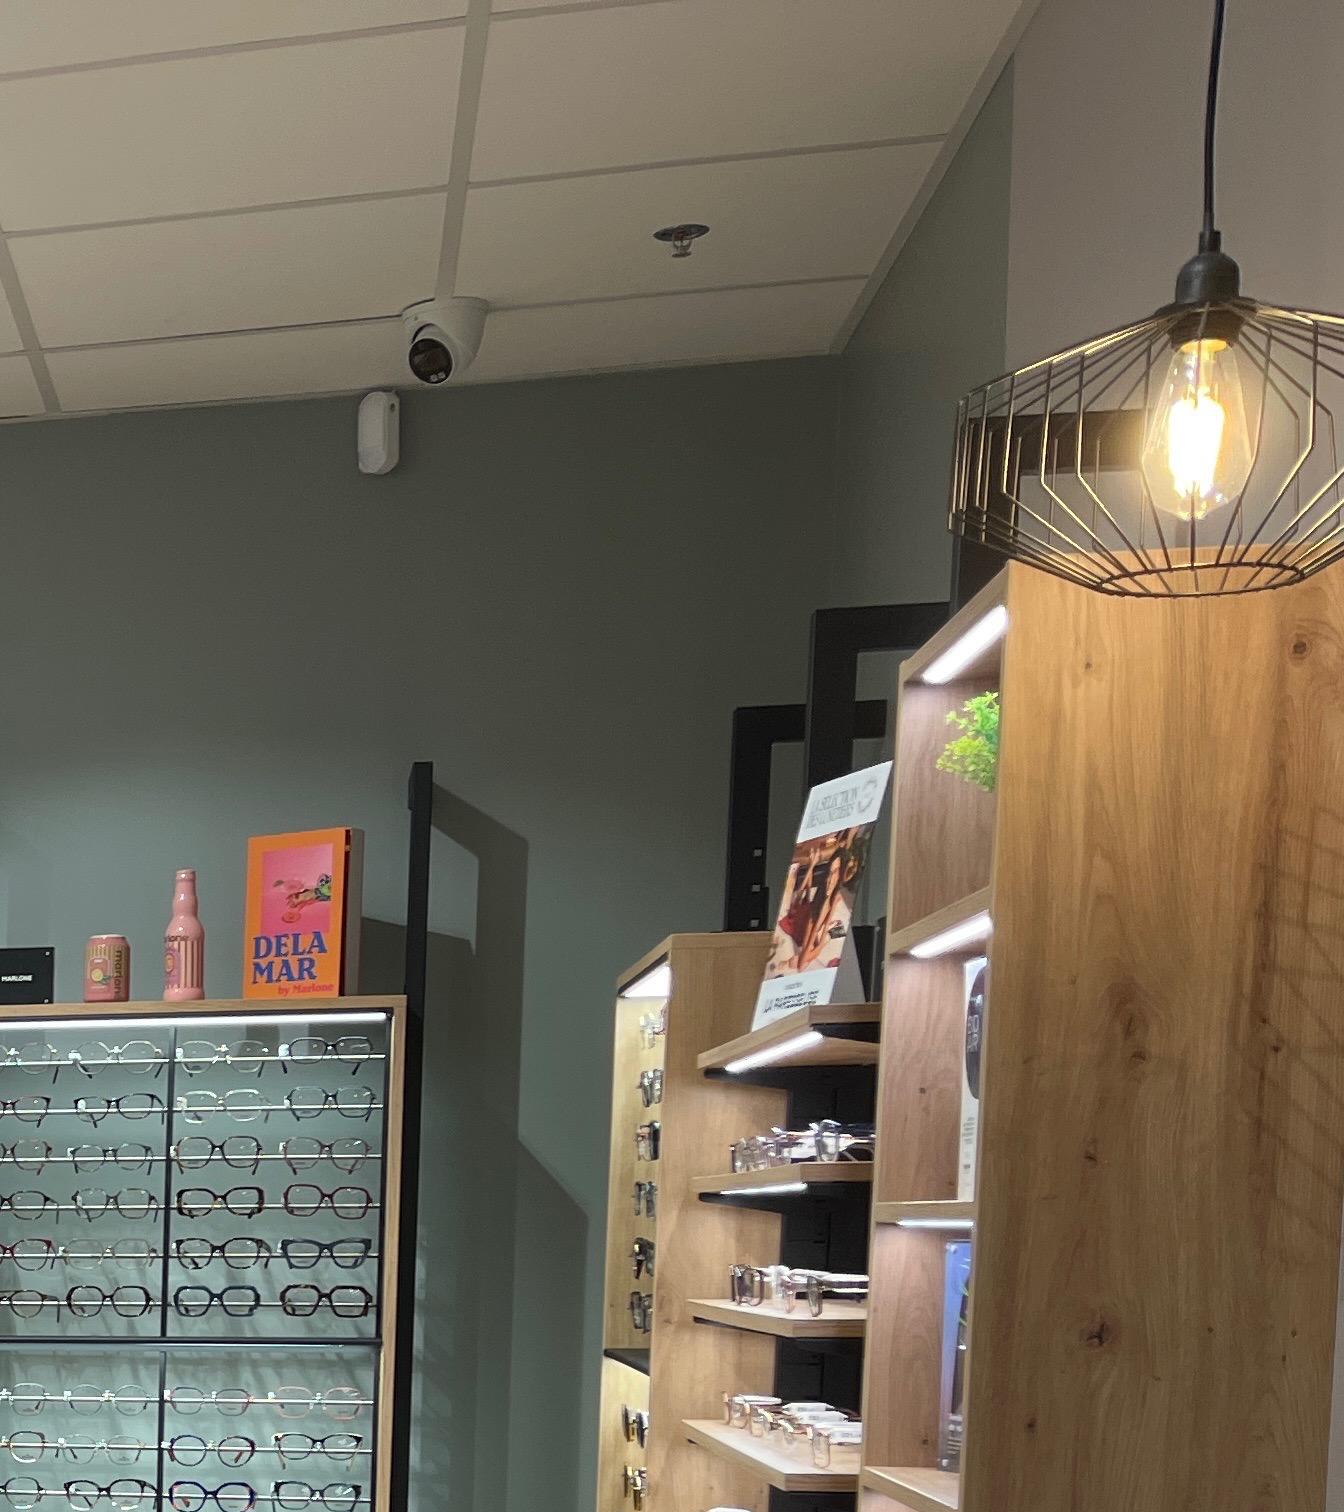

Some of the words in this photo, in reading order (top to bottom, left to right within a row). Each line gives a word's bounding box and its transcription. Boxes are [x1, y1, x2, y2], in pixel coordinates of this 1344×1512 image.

[251, 957, 317, 984] MAR
[1, 974, 32, 982] MARLONE
[278, 984, 289, 996] by
